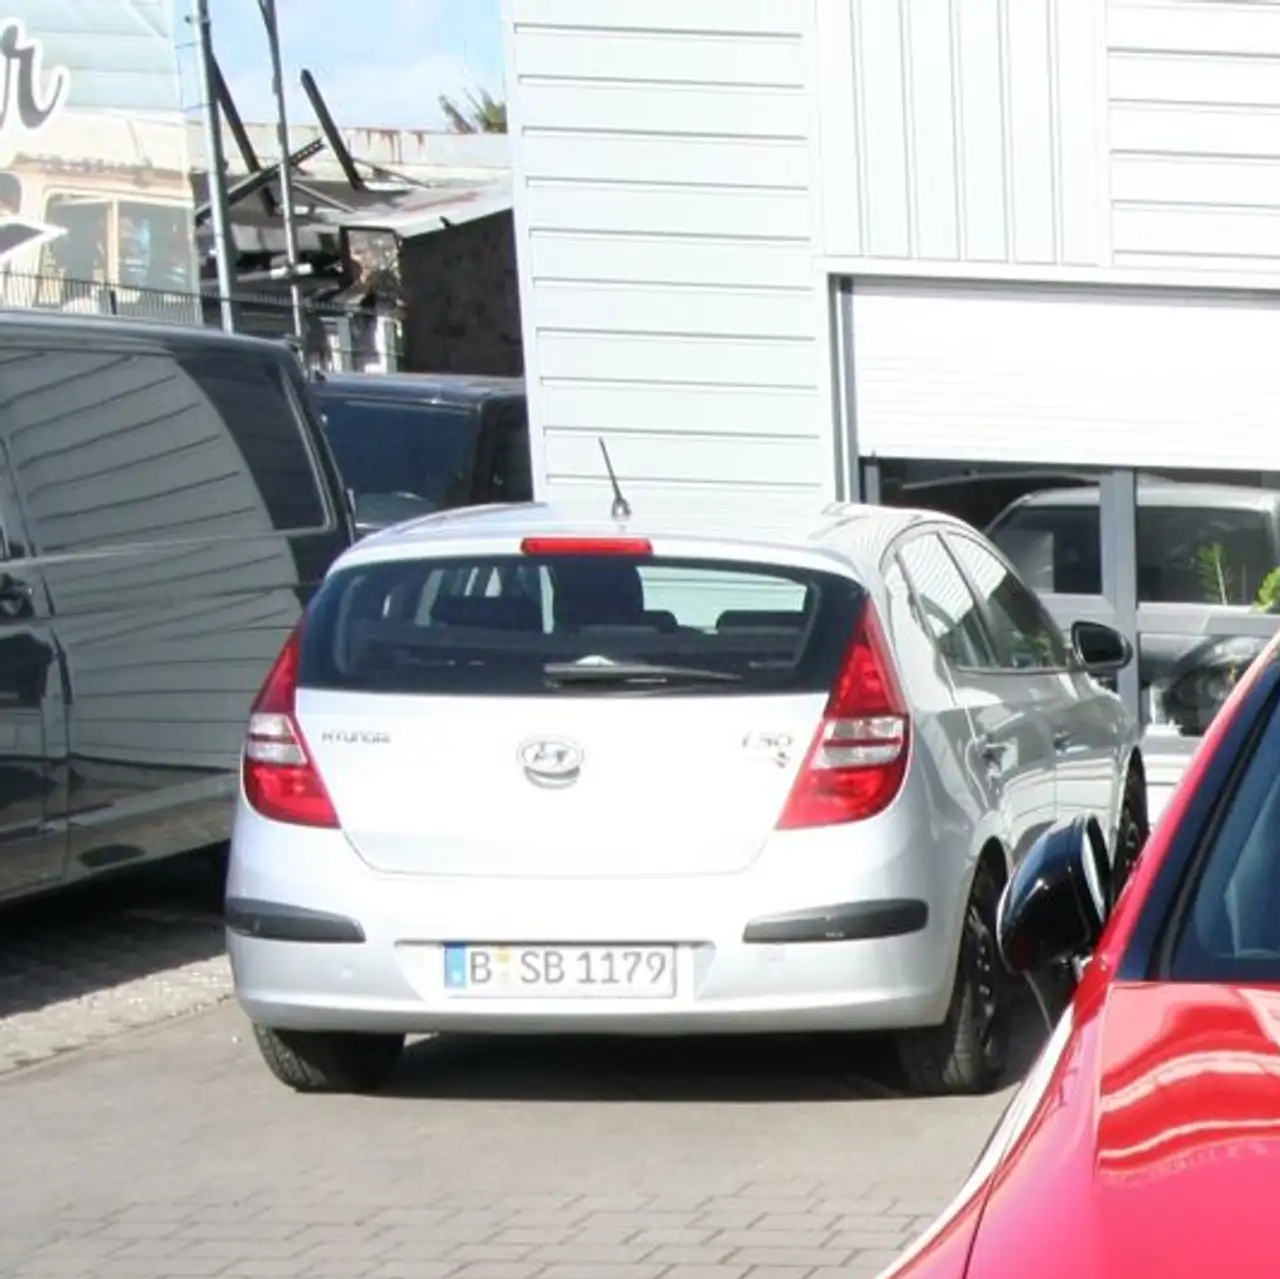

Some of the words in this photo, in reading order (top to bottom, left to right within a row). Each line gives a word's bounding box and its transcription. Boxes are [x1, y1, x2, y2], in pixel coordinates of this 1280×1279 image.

[470, 951, 491, 984] B
[520, 951, 565, 984] SB
[576, 951, 667, 985] 1179
